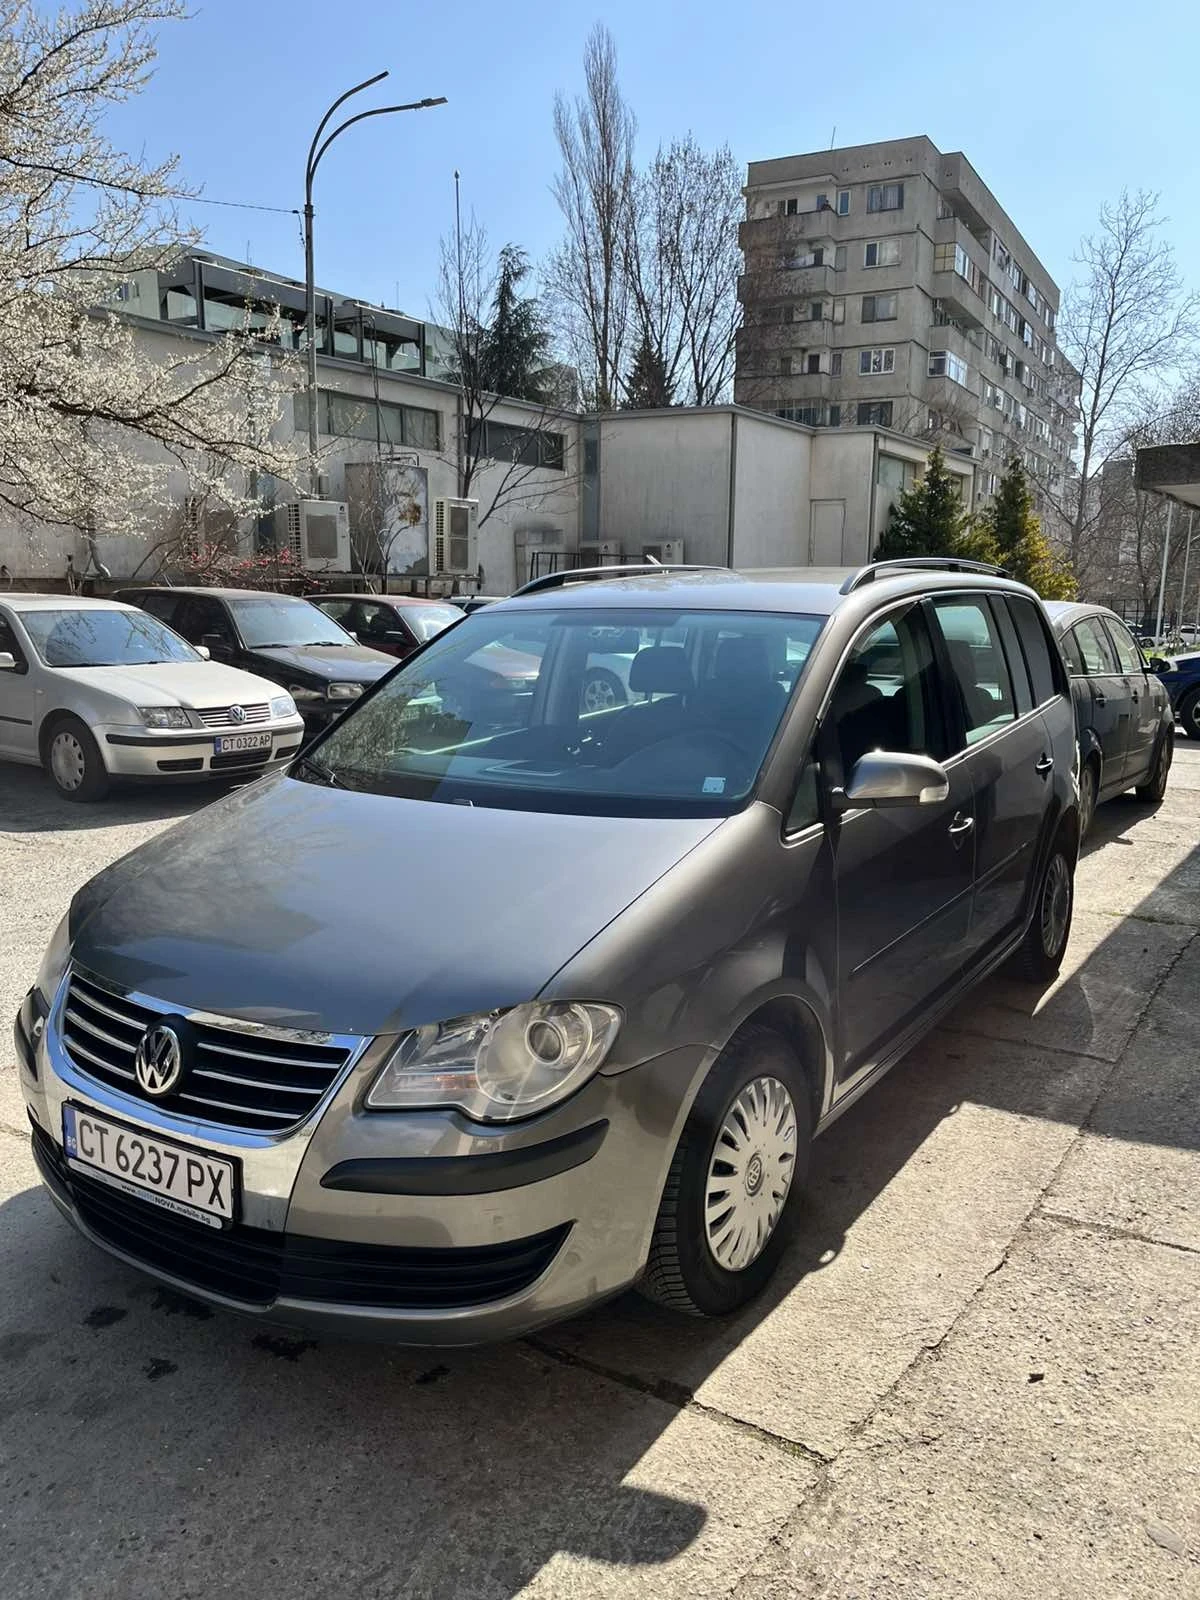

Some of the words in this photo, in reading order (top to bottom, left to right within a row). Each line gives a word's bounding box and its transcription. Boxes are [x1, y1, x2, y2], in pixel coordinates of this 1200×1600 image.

[222, 738, 235, 751] CT
[236, 736, 258, 749] 0322
[259, 734, 270, 746] AP
[79, 1119, 109, 1163] CT
[115, 1134, 180, 1190] 6237
[186, 1158, 225, 1210] PX
